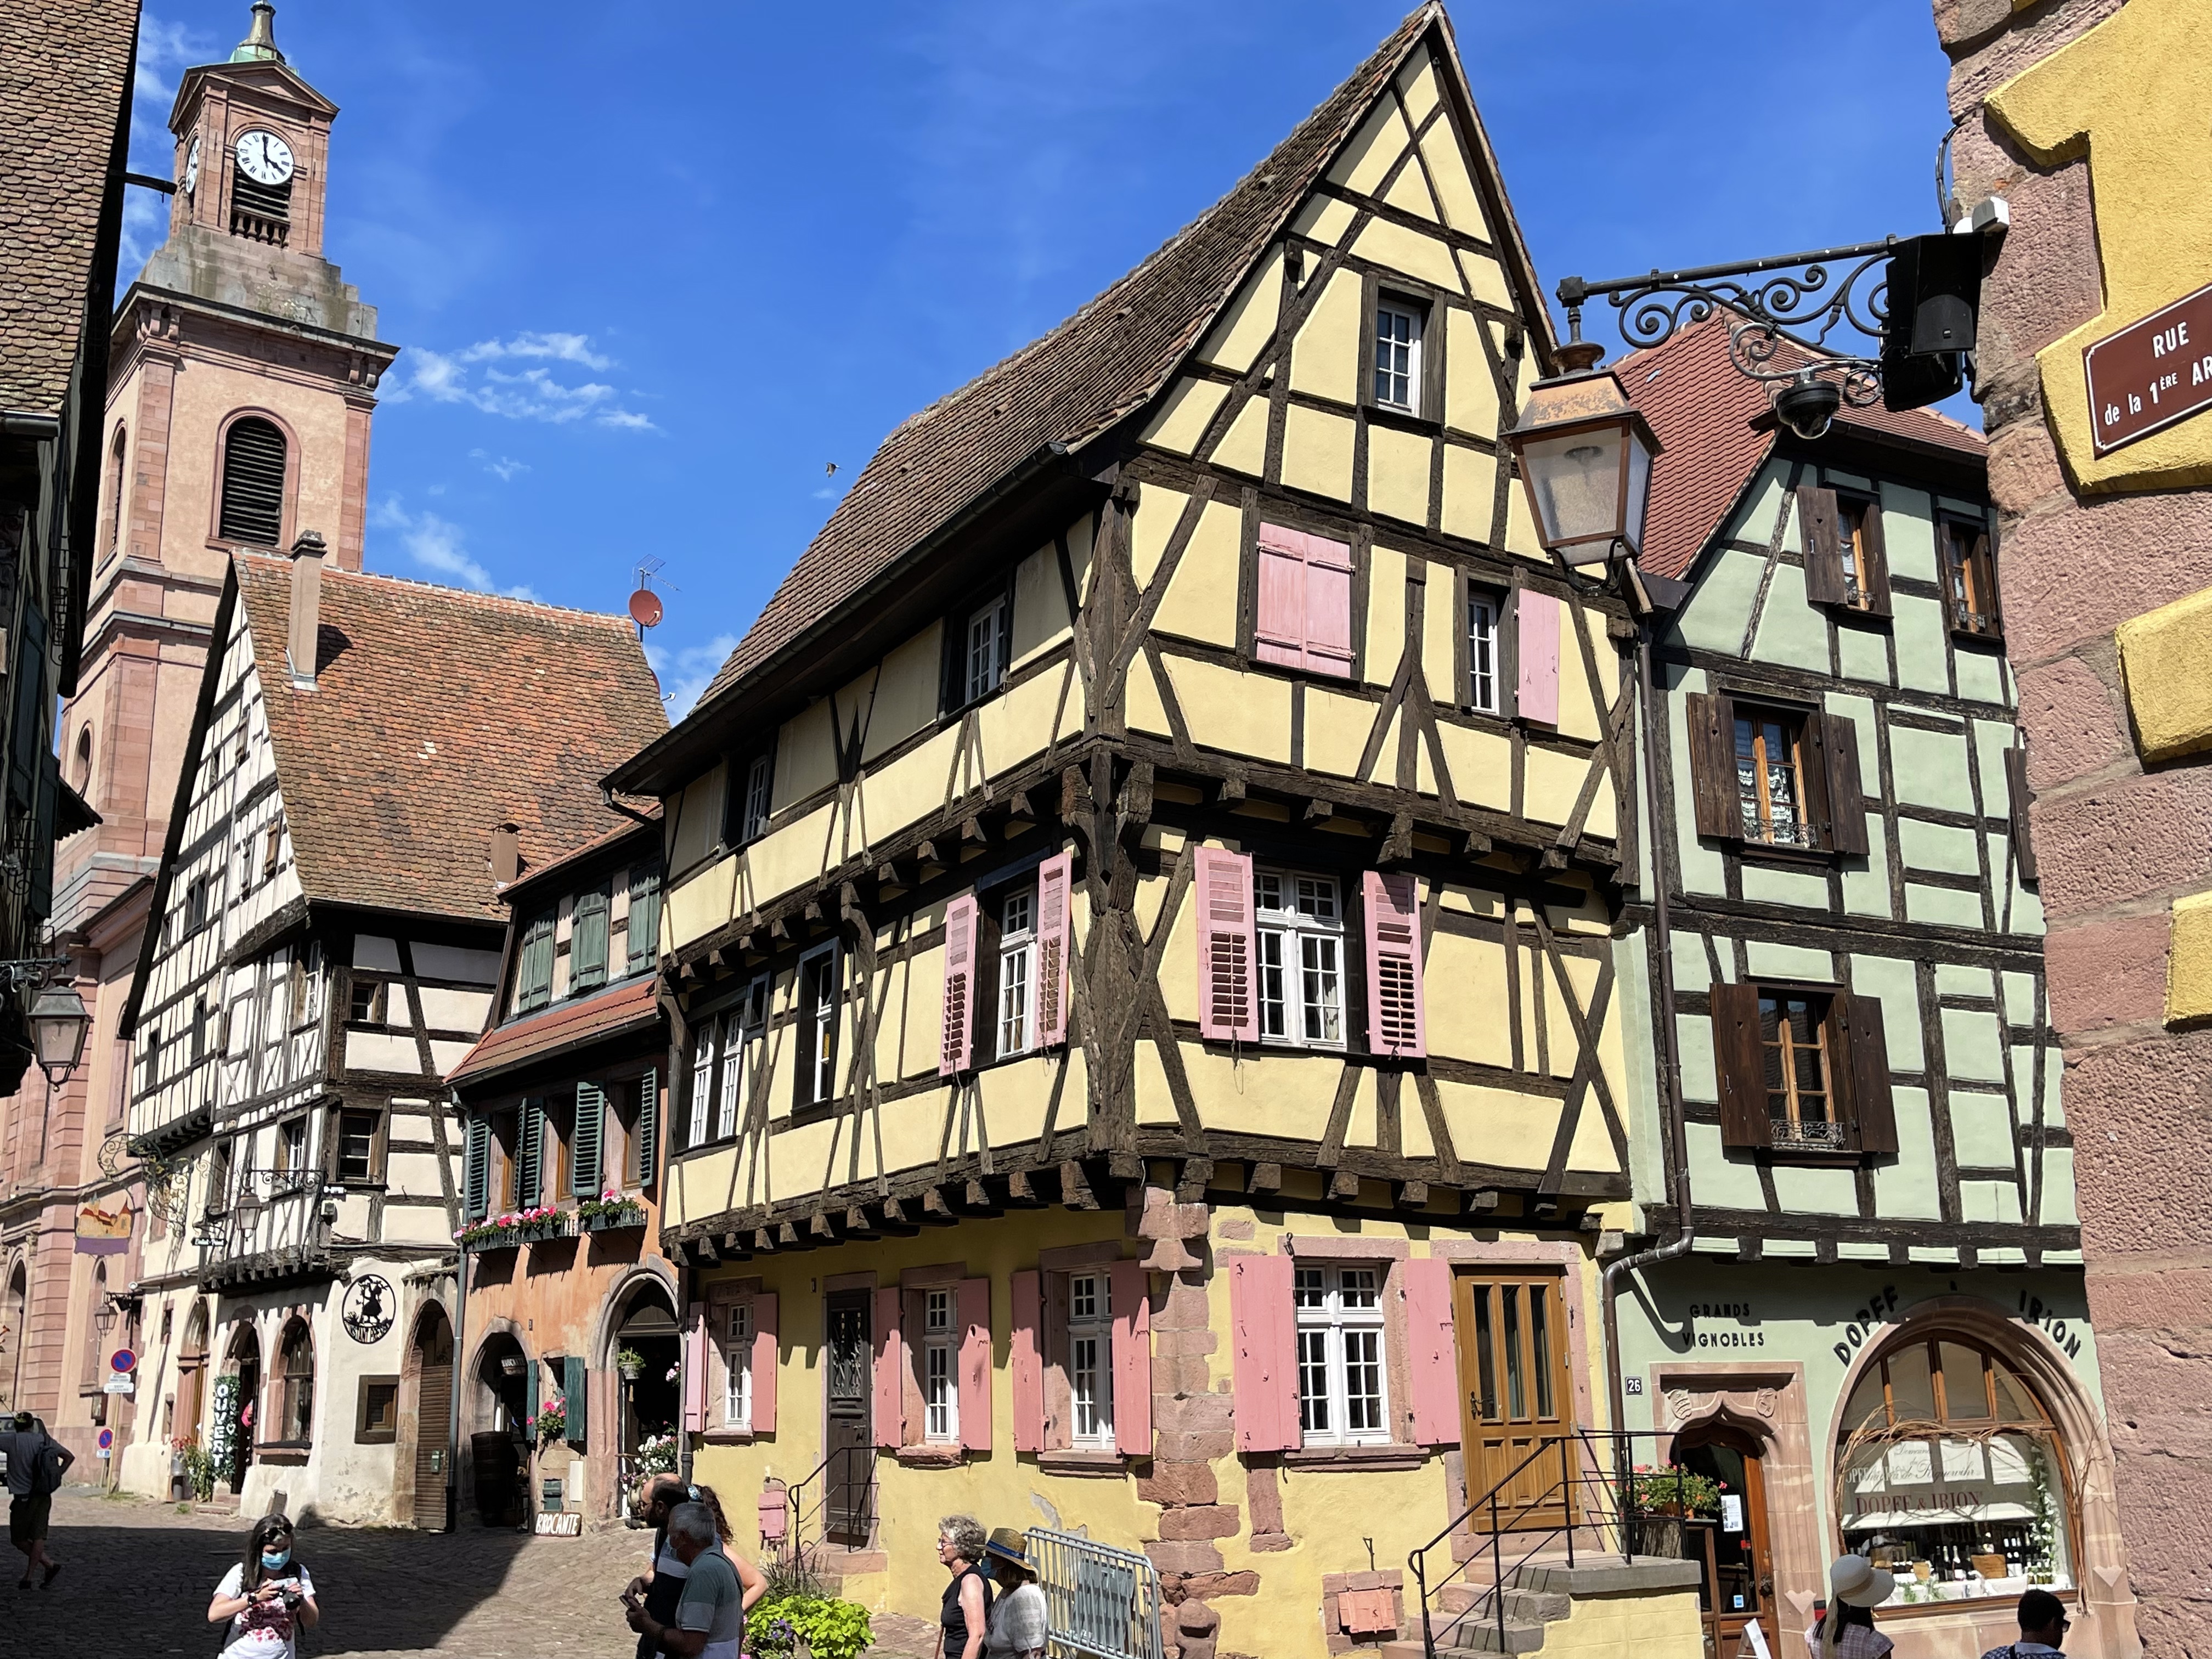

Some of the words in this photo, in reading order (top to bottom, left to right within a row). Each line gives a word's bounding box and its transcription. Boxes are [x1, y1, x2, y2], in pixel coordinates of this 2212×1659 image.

[2152, 321, 2190, 358] RUE
[2104, 403, 2120, 426] de
[2128, 393, 2141, 415] la
[1690, 1303, 1750, 1318] GRANDS
[1833, 1285, 1899, 1367] DOPFF
[2019, 1290, 2081, 1360] IRION
[1683, 1332, 1764, 1347] VIGNOBLES
[1628, 1379, 1641, 1393] 26
[212, 1384, 228, 1467] OUVERT
[1856, 1495, 1911, 1515] DOPFF
[1917, 1498, 1927, 1510] &
[1932, 1492, 1982, 1510] IRION
[535, 1512, 580, 1535] BROCANTE
